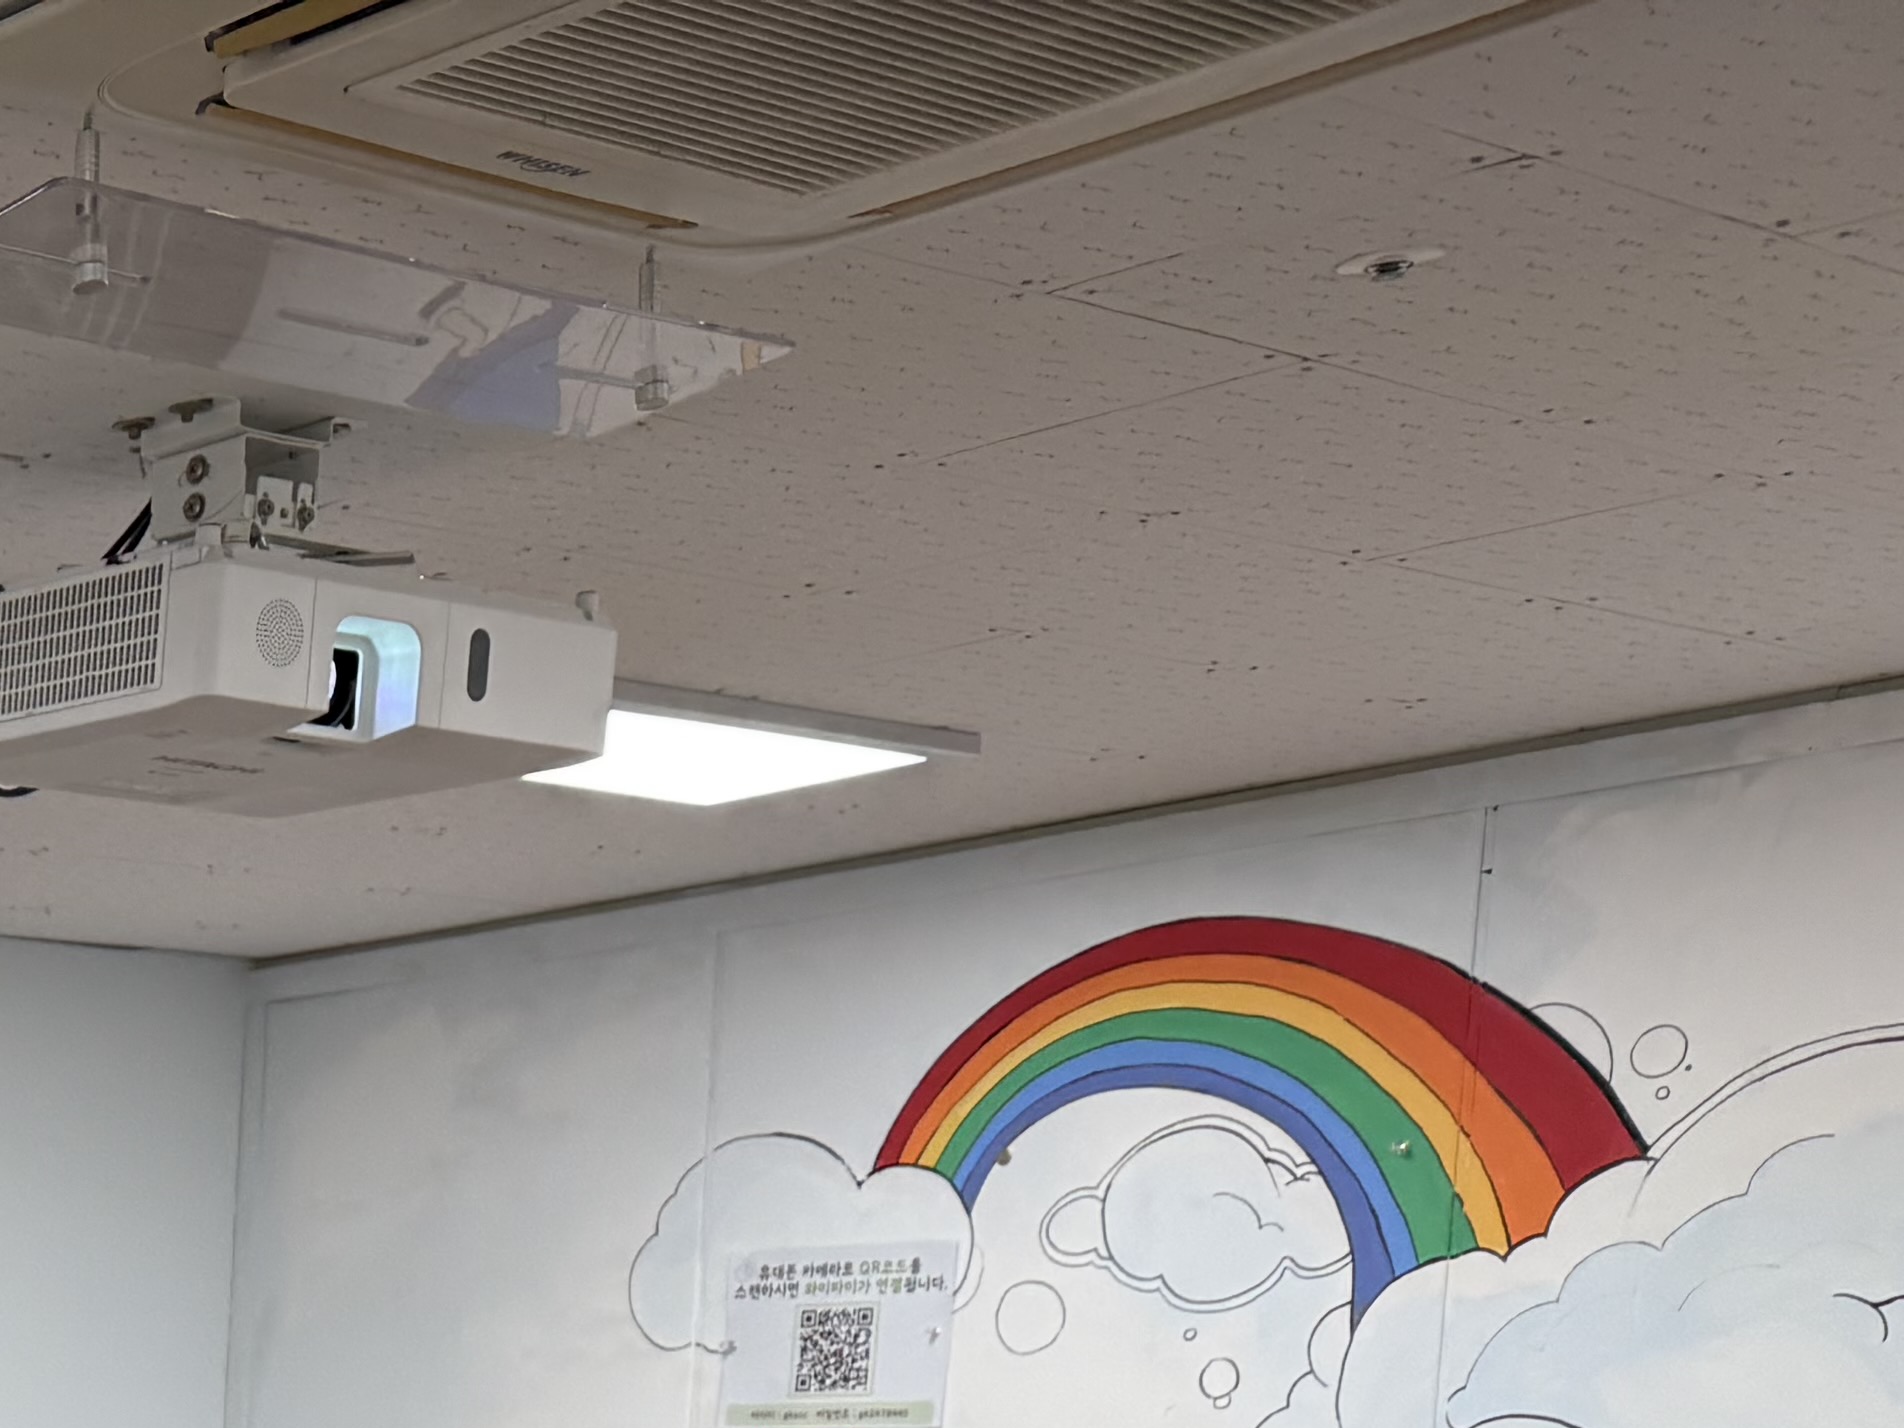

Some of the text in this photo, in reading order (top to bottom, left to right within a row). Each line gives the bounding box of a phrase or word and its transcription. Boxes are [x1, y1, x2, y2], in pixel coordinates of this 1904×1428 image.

[496, 151, 591, 177] WHISEN
[758, 1257, 921, 1281] 휴대폰 카메라로 QR코드를
[735, 1281, 799, 1300] 스캔하시면
[804, 1276, 871, 1296] 와이파이가
